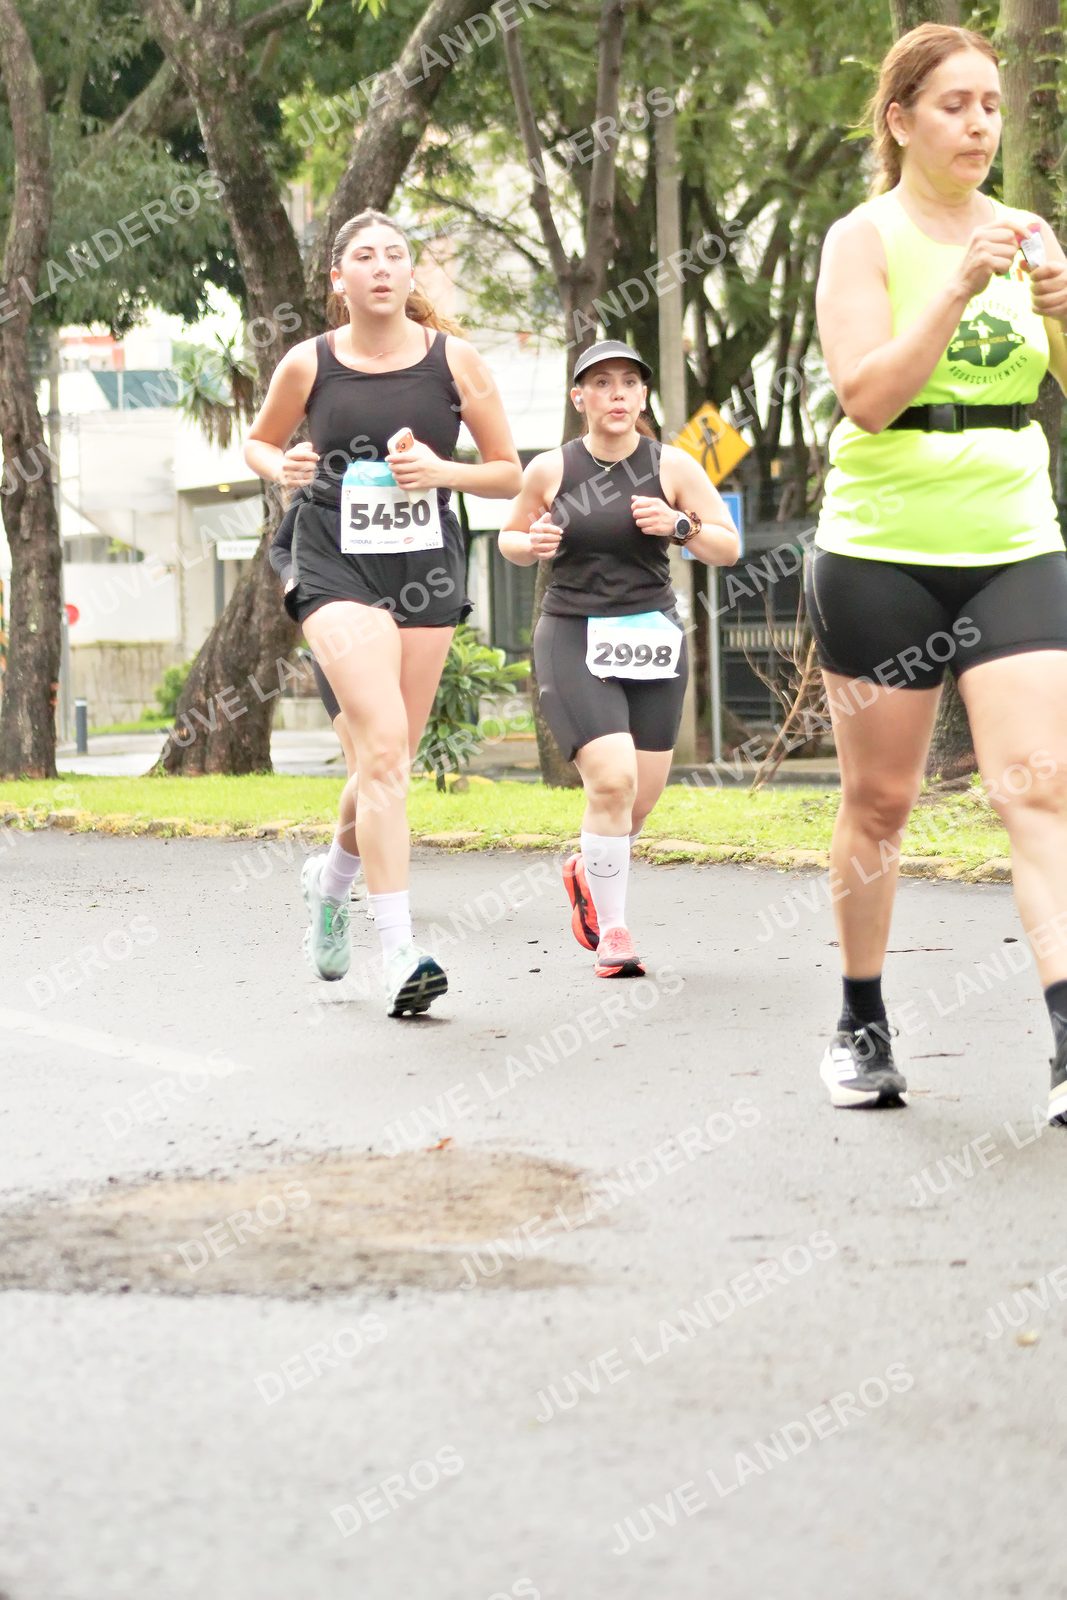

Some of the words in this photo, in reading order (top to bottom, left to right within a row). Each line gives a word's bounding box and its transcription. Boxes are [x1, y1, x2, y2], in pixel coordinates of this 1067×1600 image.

[949, 354, 1028, 385] AGUASCALIENTES
[350, 500, 430, 530] 5450
[593, 642, 672, 667] 2998
